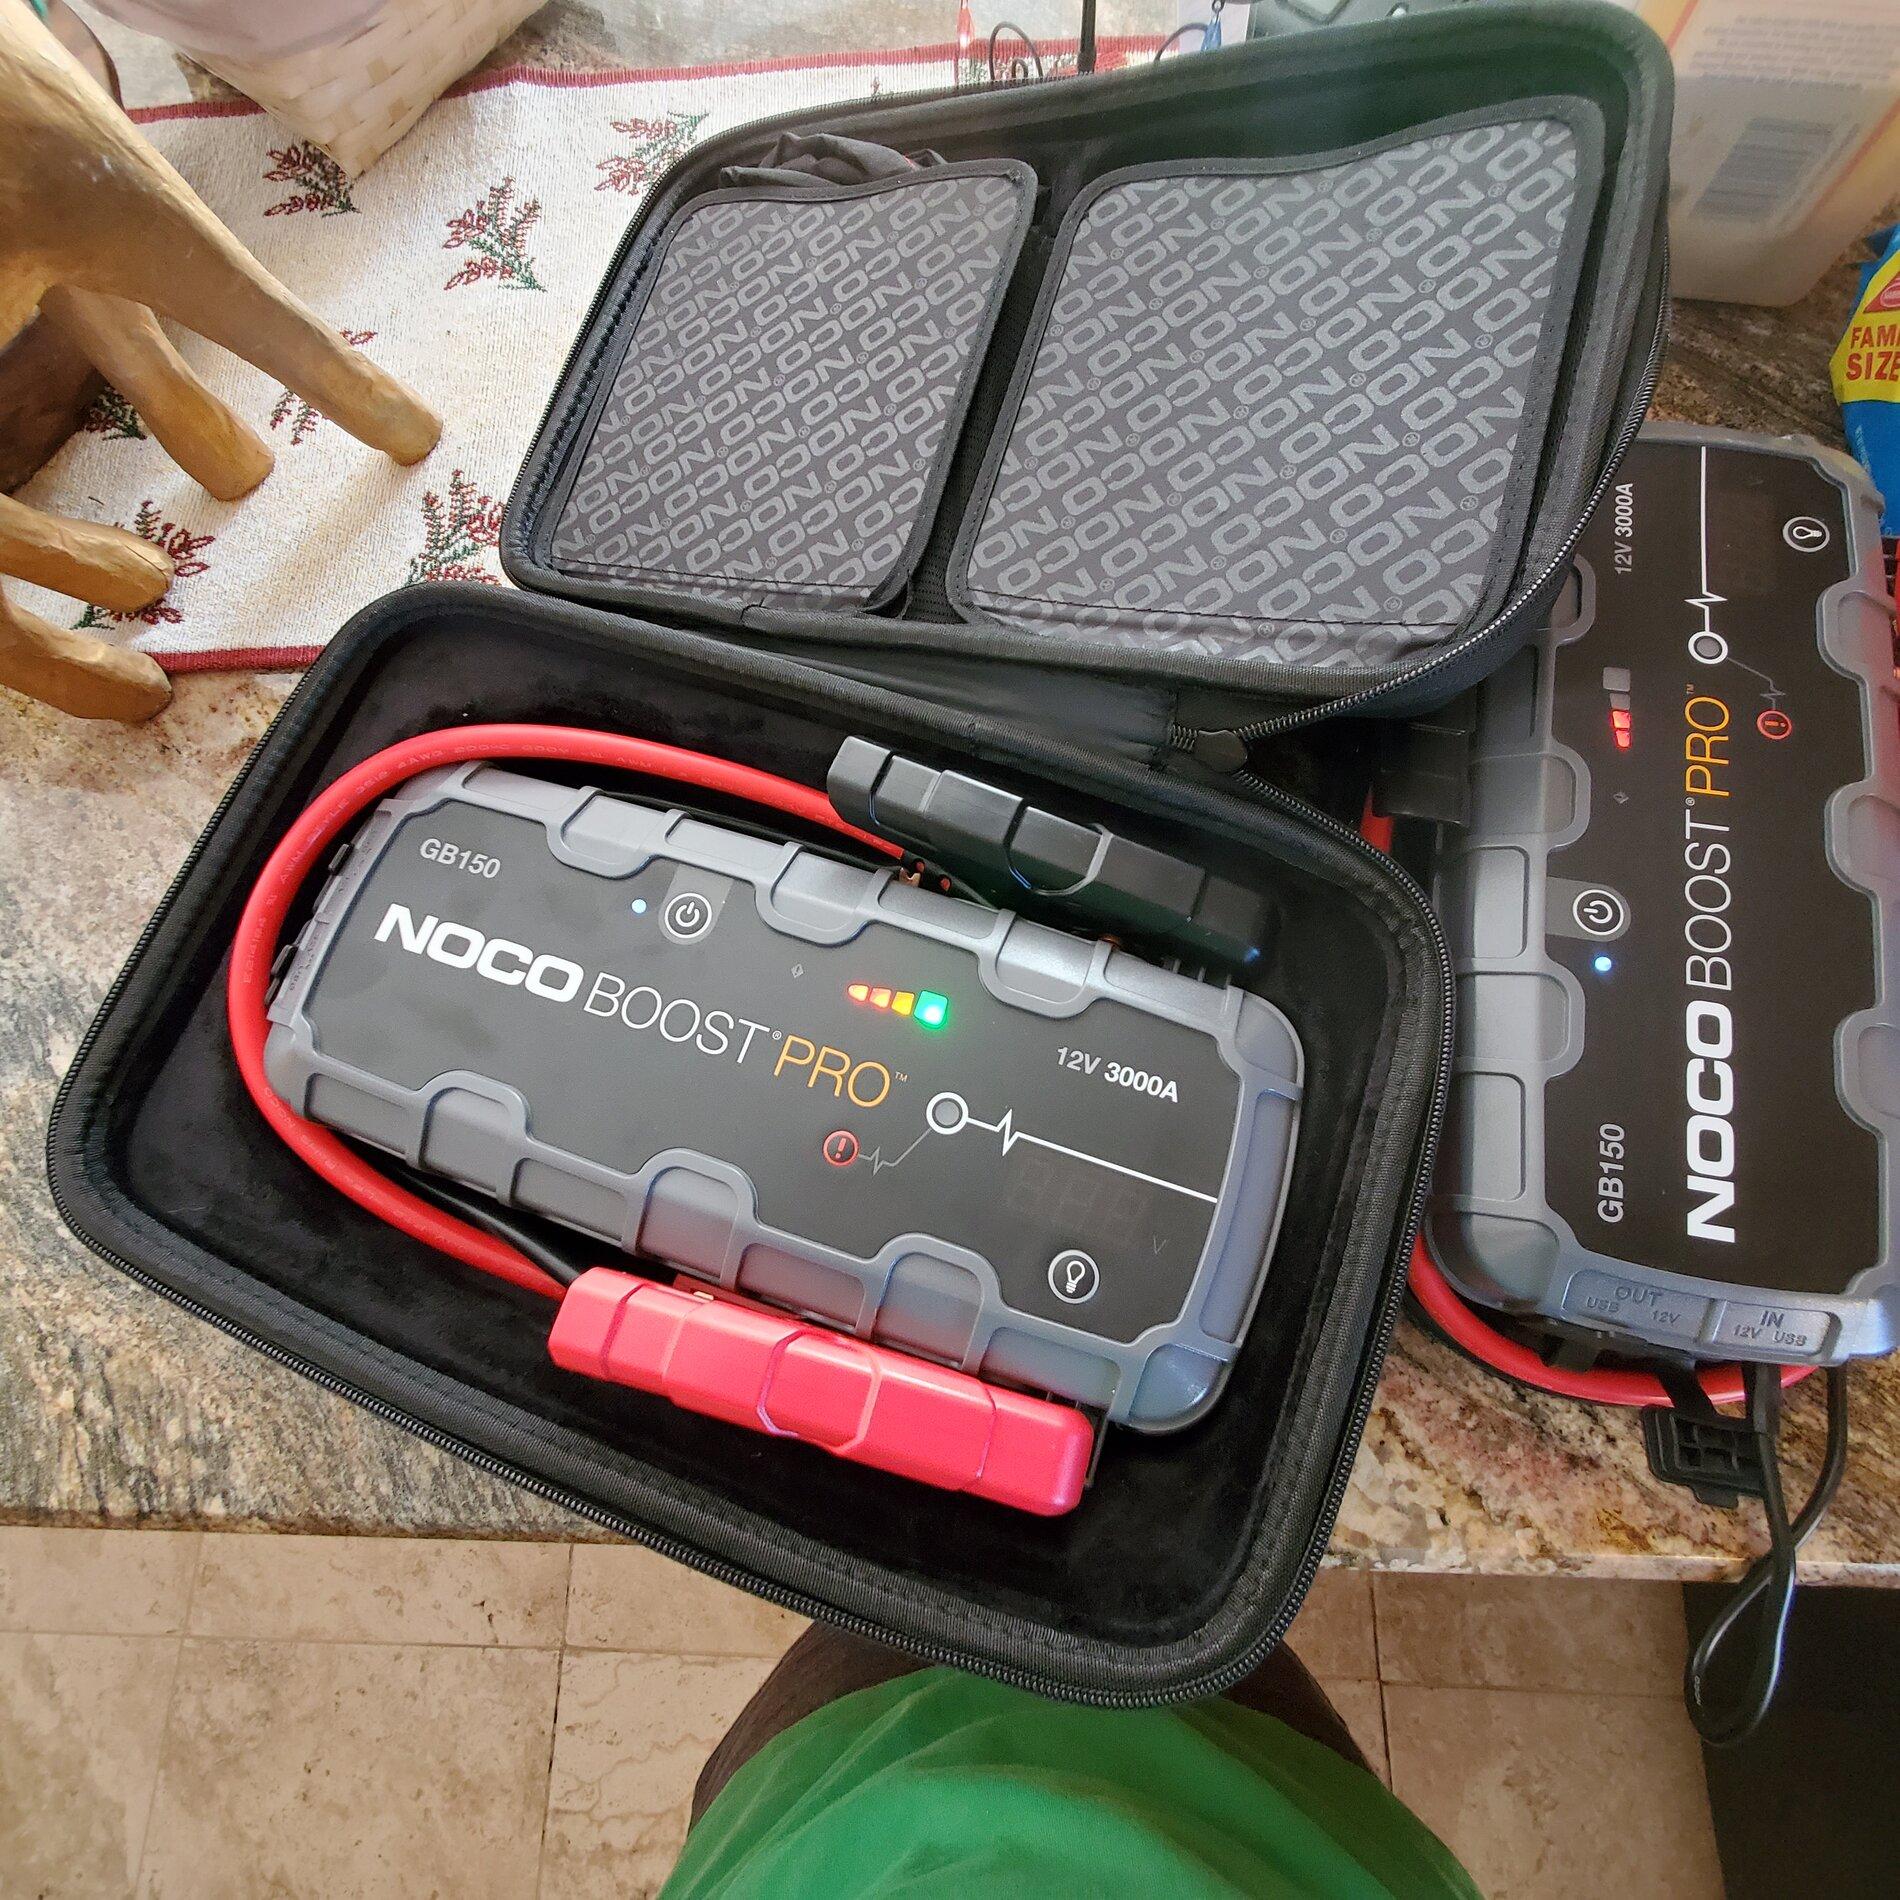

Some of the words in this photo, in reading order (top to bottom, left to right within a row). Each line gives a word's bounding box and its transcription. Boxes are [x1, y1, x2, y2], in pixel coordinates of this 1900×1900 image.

[832, 199, 970, 302] NOCO
[1150, 177, 1313, 296] NOCO
[1254, 142, 1429, 267] NOCO
[1300, 181, 1484, 316] NOCO
[660, 211, 785, 304] NOCO
[678, 251, 803, 348] NOCO
[754, 226, 884, 326] NOCO
[858, 245, 1000, 350] NOCO
[1052, 212, 1207, 323] NOCO
[1190, 224, 1362, 349] NOCO
[1348, 231, 1542, 372] NOCO
[624, 320, 748, 414] NOCO
[698, 297, 828, 394] NOCO
[776, 272, 912, 374] NOCO
[1088, 260, 1250, 376] NOCO
[1234, 275, 1414, 404] NOCO
[1846, 350, 1900, 381] SIZE
[644, 367, 771, 464] NOCO
[720, 345, 854, 445] NOCO
[801, 320, 941, 425] NOCO
[1026, 343, 1186, 456] NOCO
[1126, 312, 1296, 432] NOCO
[1280, 329, 1470, 464] NOCO
[664, 418, 796, 517] NOCO
[744, 396, 880, 499] NOCO
[1062, 398, 1230, 515] NOCO
[1167, 366, 1345, 492] NOCO
[1330, 387, 1524, 528] NOCO
[588, 438, 714, 534] NOCO
[686, 472, 822, 572] NOCO
[768, 450, 910, 556] NOCO
[1100, 456, 1275, 578] NOCO
[1211, 424, 1398, 557] NOCO
[1615, 482, 1634, 537] 3000A
[997, 484, 1162, 594] NOCO
[1144, 520, 1326, 645] NOCO
[1258, 488, 1455, 626] NOCO
[1615, 541, 1634, 575] 12V
[1685, 696, 1731, 798] PRO
[420, 838, 501, 879] GB150
[374, 903, 584, 1002] NOCO
[773, 1035, 891, 1108] PRO
[1057, 1046, 1101, 1075] 12V
[1104, 1062, 1178, 1103] 3000A
[1686, 1000, 1736, 1243] NOCO
[1598, 1123, 1626, 1223] GB150
[1586, 1297, 1619, 1313] USB
[1652, 1310, 1681, 1324] 12V
[1615, 1286, 1662, 1307] OUT
[1733, 1324, 1761, 1340] 12V
[1772, 1331, 1808, 1347] USB
[1760, 1310, 1784, 1328] IN
